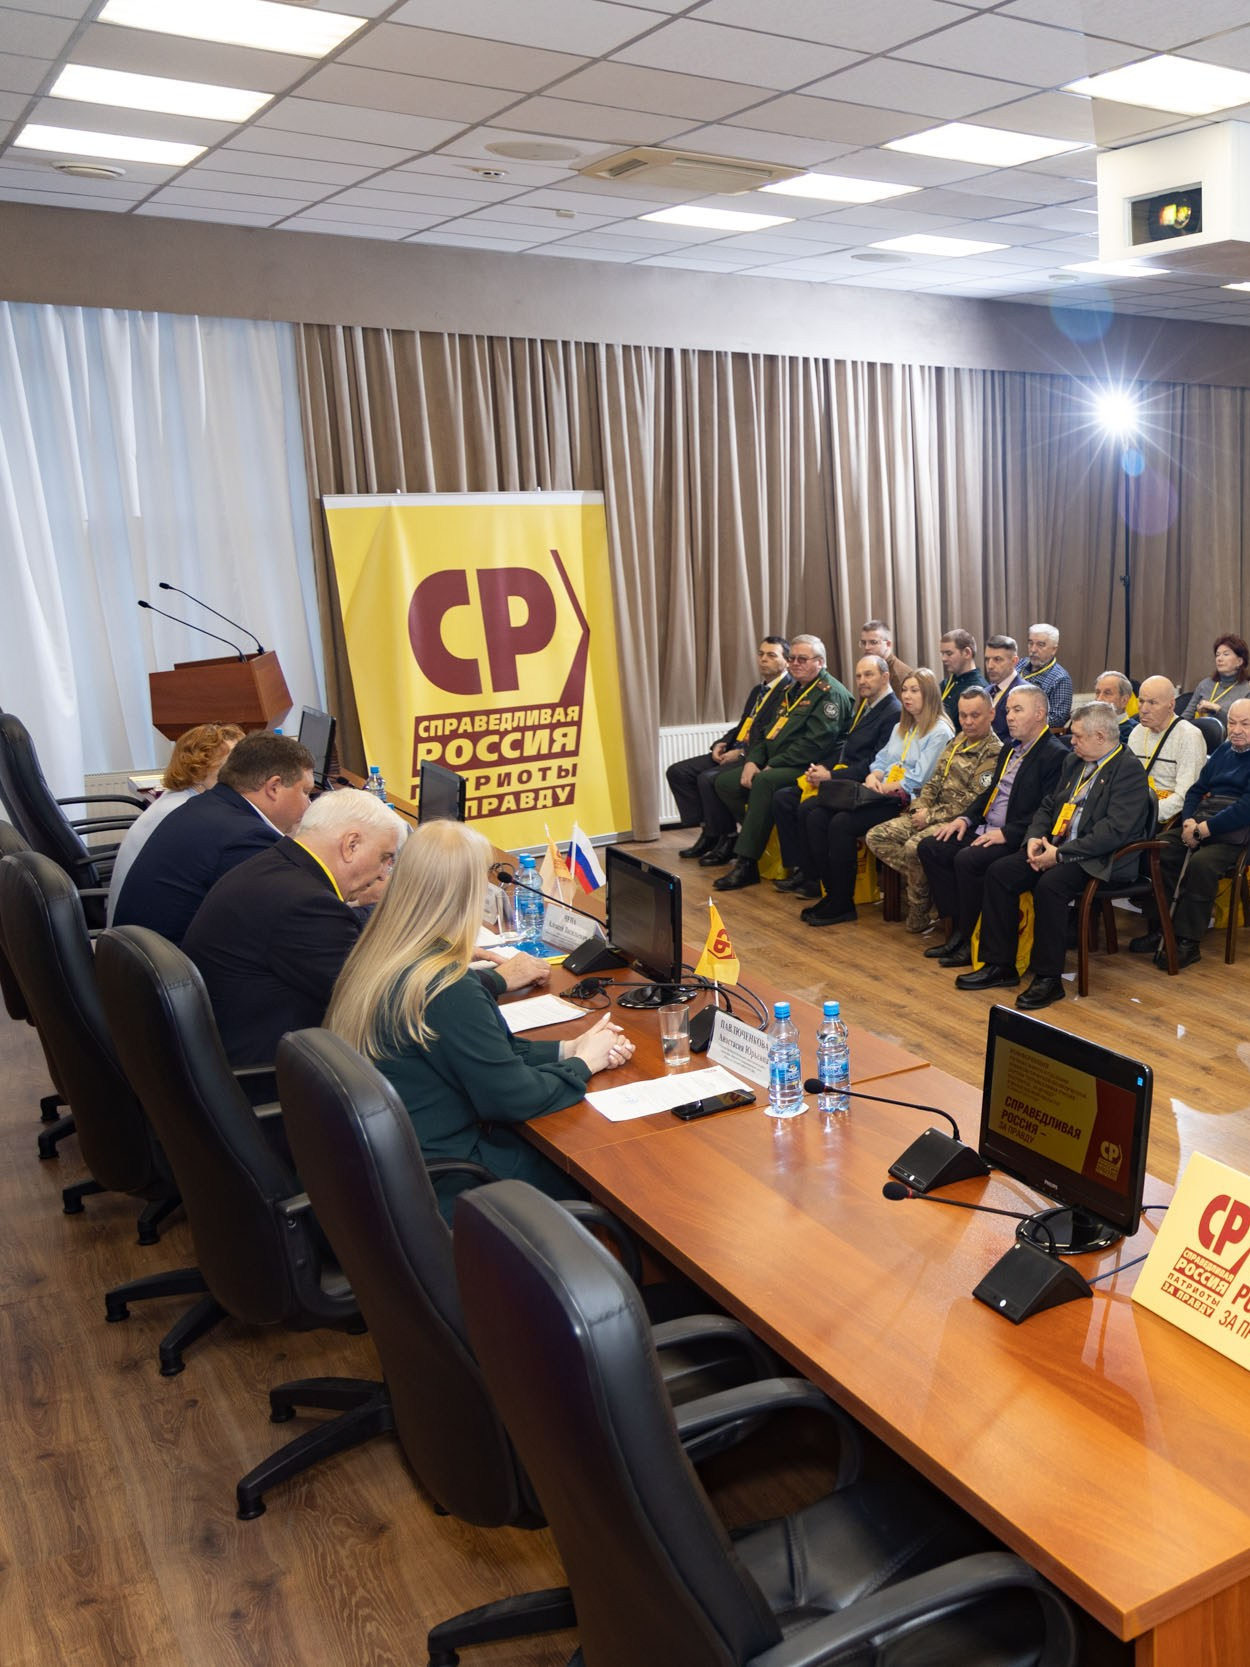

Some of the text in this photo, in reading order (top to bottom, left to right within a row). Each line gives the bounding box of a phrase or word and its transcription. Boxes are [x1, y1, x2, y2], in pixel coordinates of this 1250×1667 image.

[407, 566, 557, 696] СР
[418, 705, 580, 738] СПРАВЕДЛИВАЯ
[416, 725, 578, 771] РОССИЯ
[465, 785, 572, 818] ПРАВДУ
[998, 1121, 1036, 1144] ЗА ПРАВДУ
[1001, 1110, 1039, 1135] РОССИЯ
[1004, 1096, 1082, 1140] СПРАВЕДЛИВАЯ
[1174, 1257, 1230, 1295] РОССИЯ
[1183, 1249, 1235, 1281] СПРАВЕДЛИВАЯ
[1162, 1282, 1215, 1318] ЗА ПРАВДУ
[1167, 1273, 1221, 1307] ПАТРИОТЫ
[1218, 1309, 1241, 1336] ЗА
